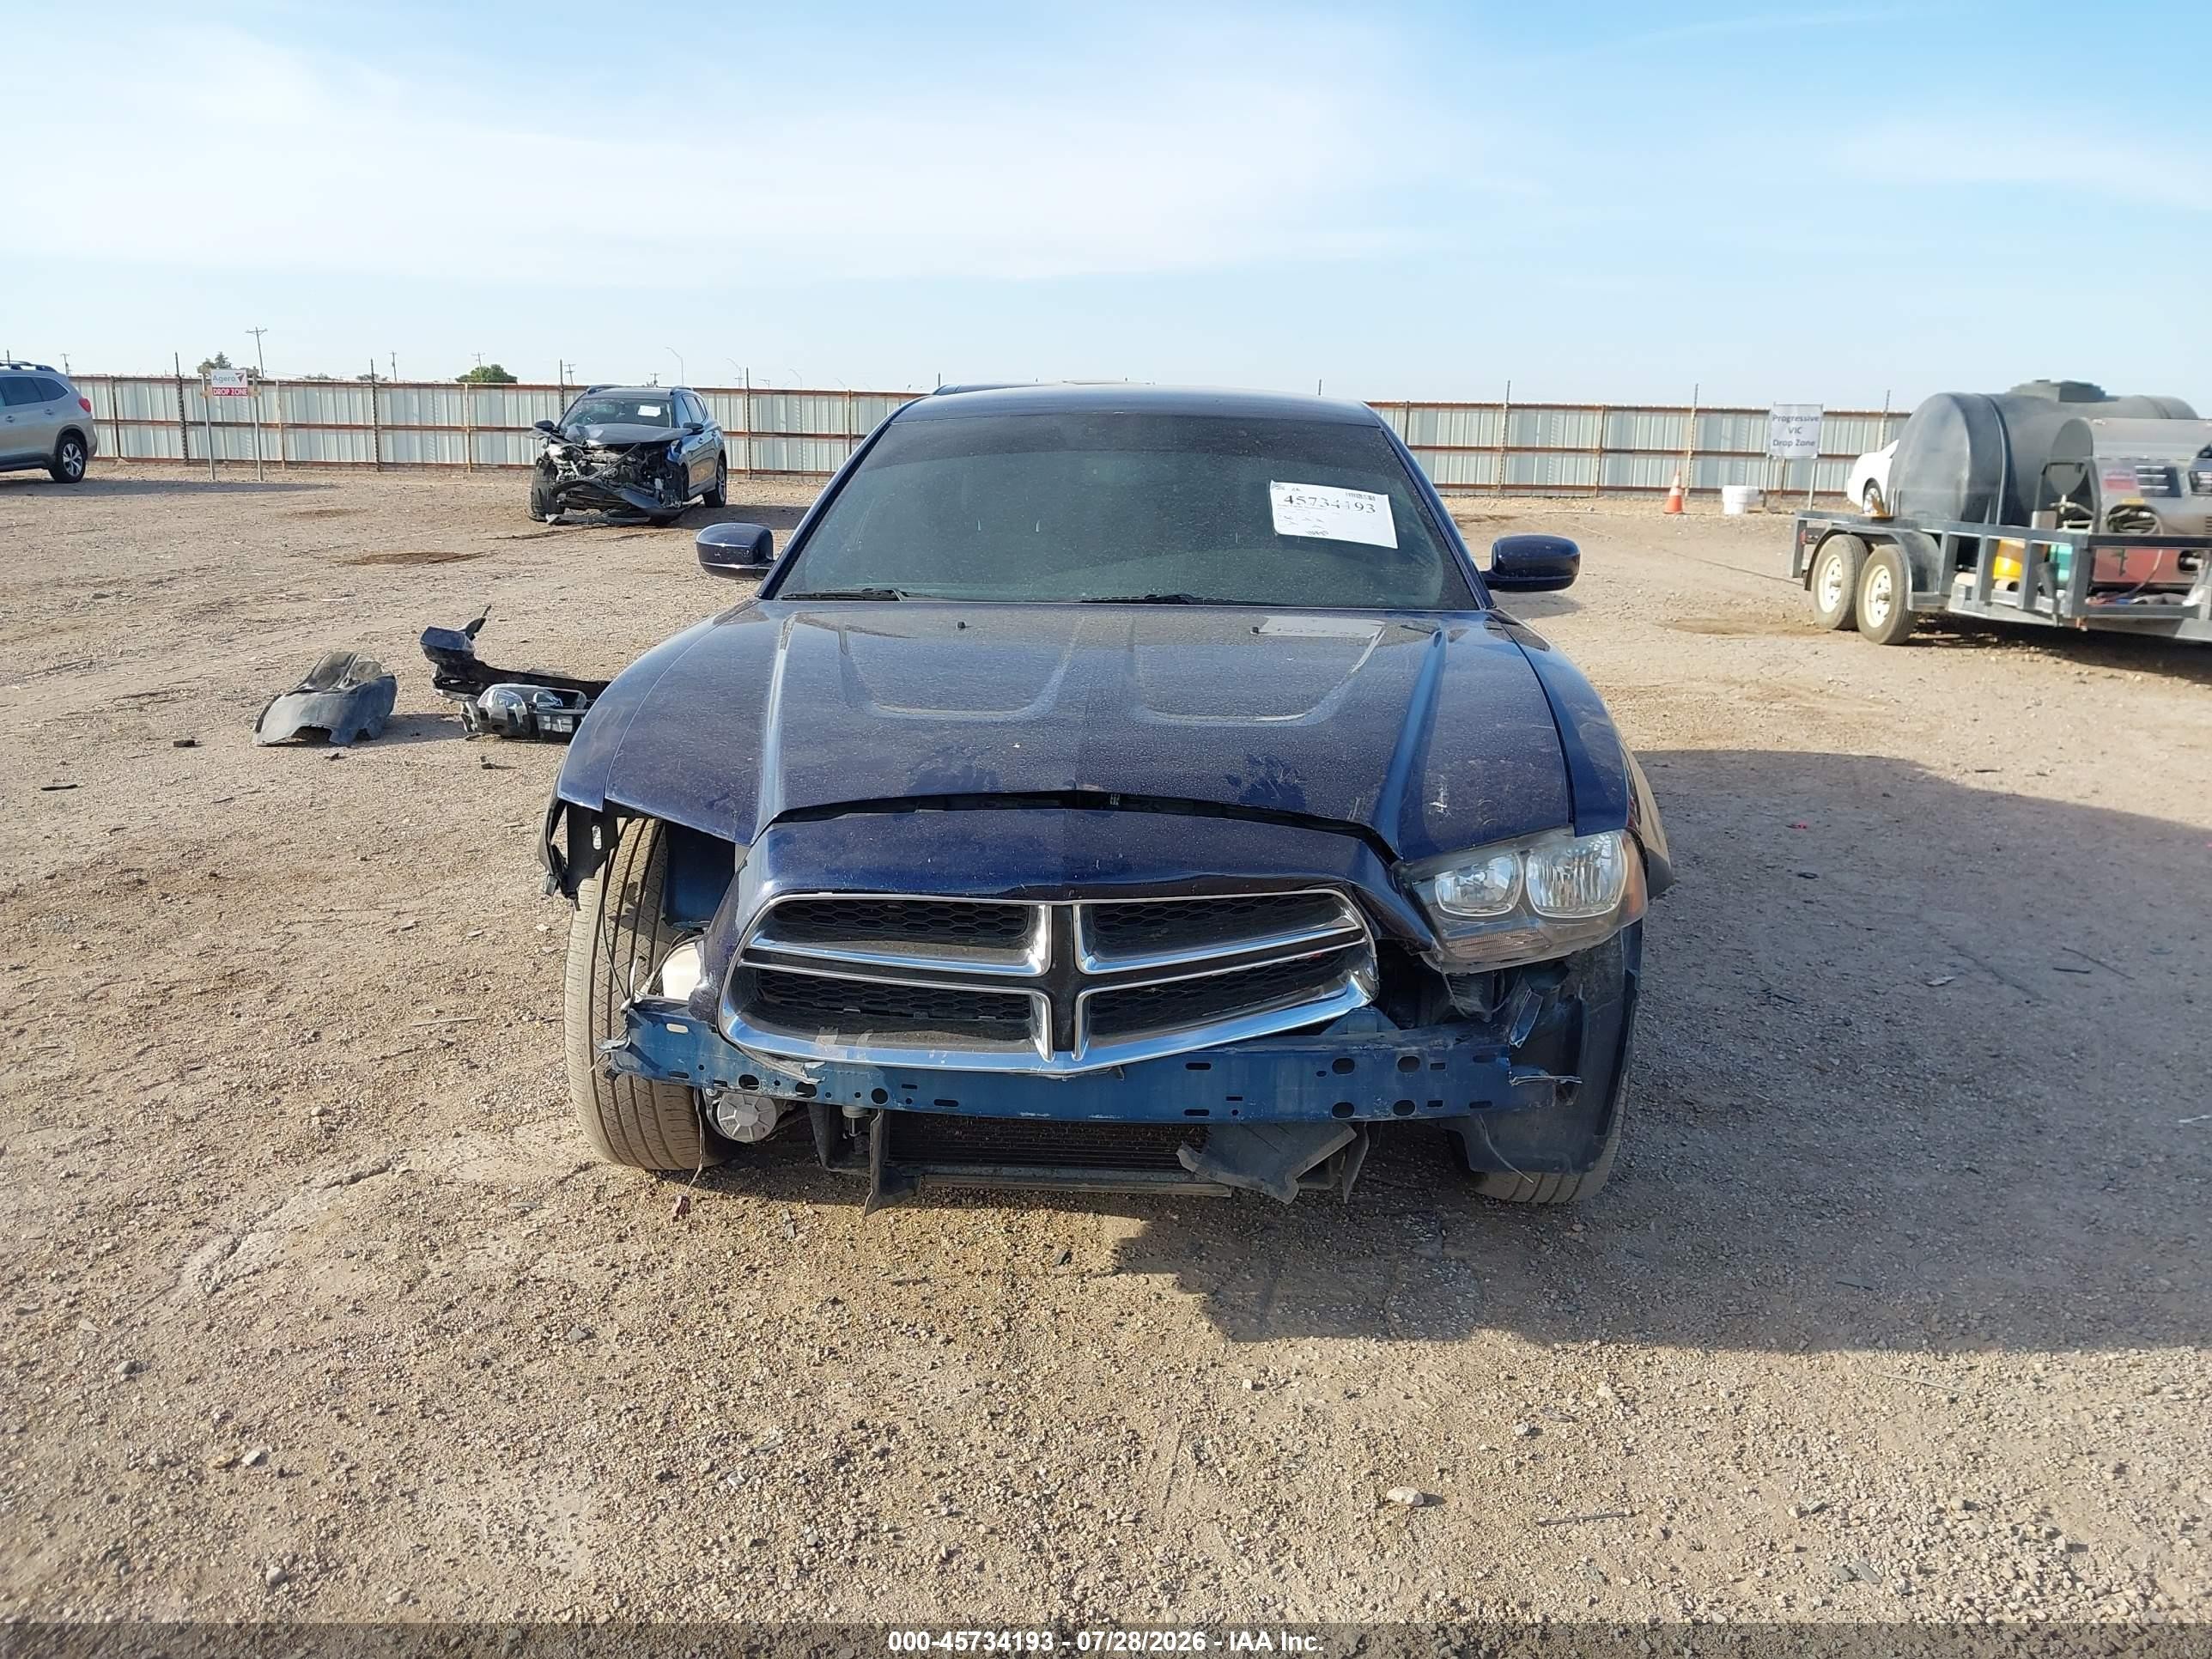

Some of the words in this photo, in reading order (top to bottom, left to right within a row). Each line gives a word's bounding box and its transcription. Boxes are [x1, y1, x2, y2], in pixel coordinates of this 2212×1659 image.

[212, 374, 236, 383] Agero
[1772, 414, 1820, 423] Progressive
[1772, 439, 1793, 447] Drop
